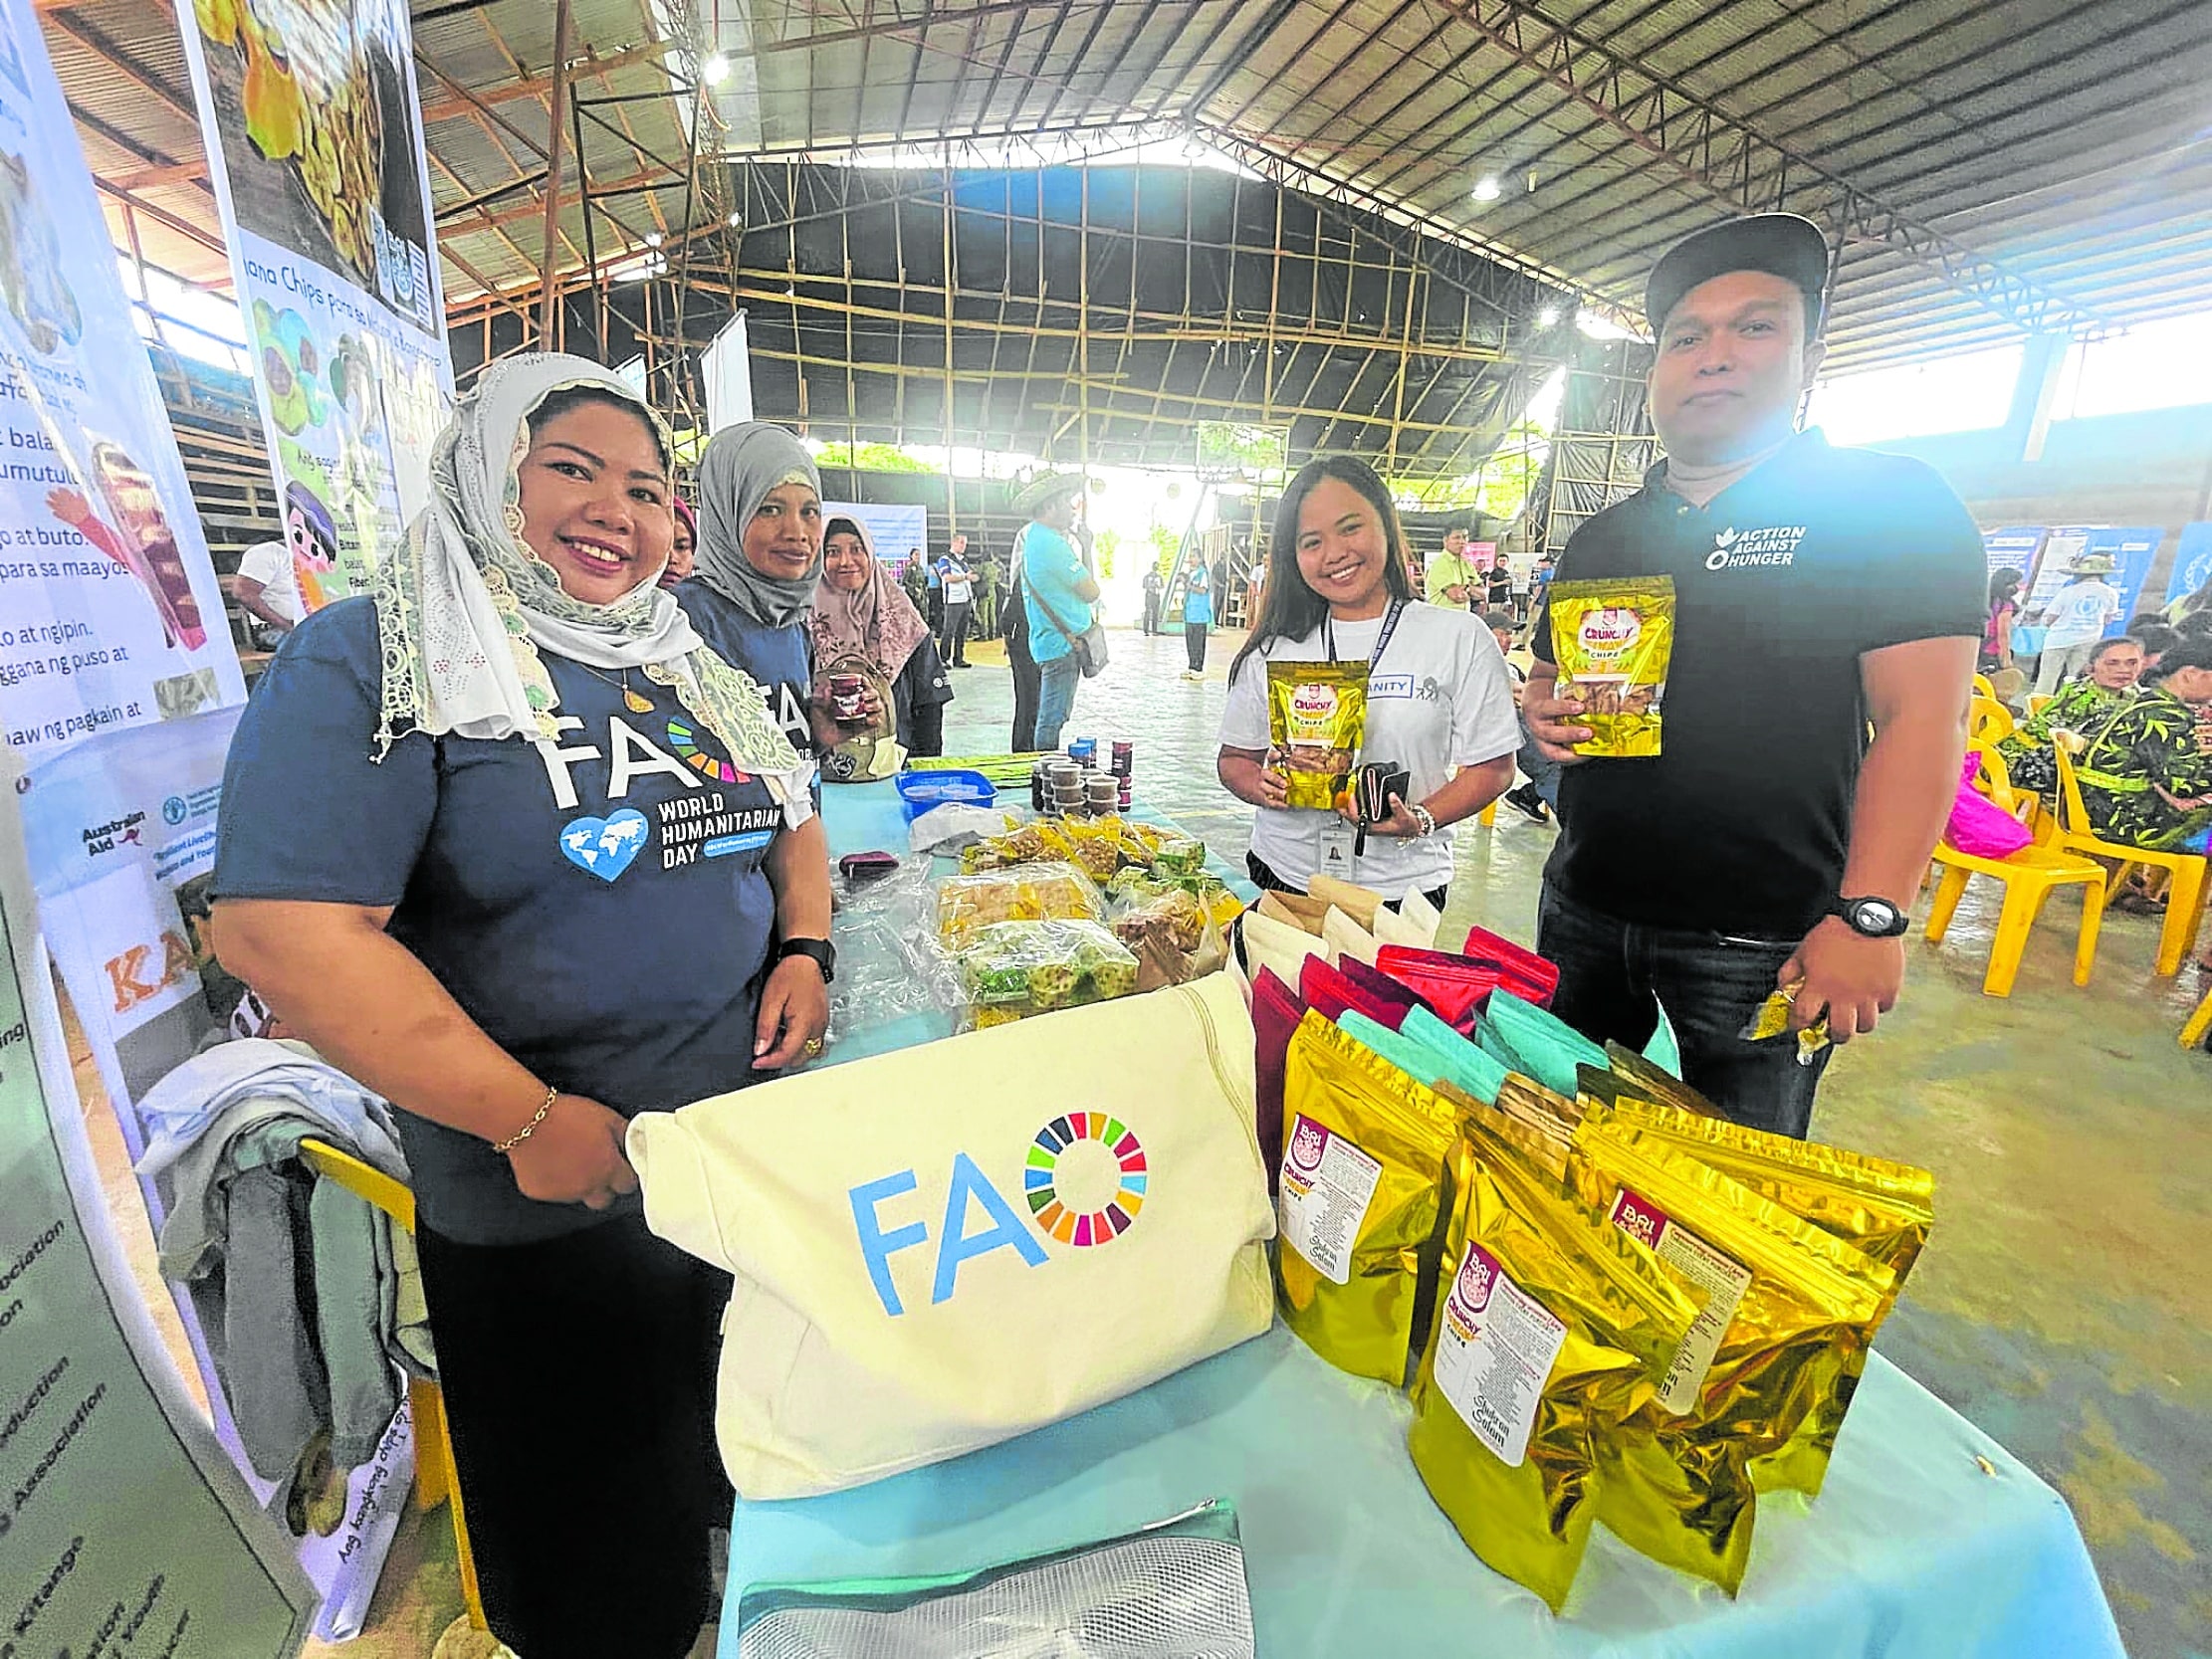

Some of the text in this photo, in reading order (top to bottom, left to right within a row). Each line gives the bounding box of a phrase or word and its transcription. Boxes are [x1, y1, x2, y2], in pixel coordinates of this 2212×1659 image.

[281, 266, 325, 309] Chips
[16, 528, 35, 545] at
[36, 526, 89, 545] buto.
[1732, 538, 1802, 554] AGAINST
[1737, 525, 1807, 542] ACTION
[0, 562, 38, 583] para
[40, 562, 60, 577] sa
[1727, 552, 1794, 567] HUNGER
[19, 626, 38, 644] at
[41, 619, 94, 645] ngipin.
[1585, 626, 1634, 640] CRUNCY
[49, 655, 69, 676] ng
[73, 650, 110, 672] puso
[112, 646, 130, 663] at
[45, 721, 66, 740] ng
[66, 707, 123, 733] pagkain
[126, 701, 142, 717] at
[657, 793, 725, 823] WORLD
[661, 808, 781, 846] HUMANITARIAN
[88, 836, 114, 857] Aid
[662, 843, 699, 870] DAY
[848, 1111, 1148, 1317] FAO
[14, 1381, 108, 1512] Association
[338, 1534, 361, 1563] Ang
